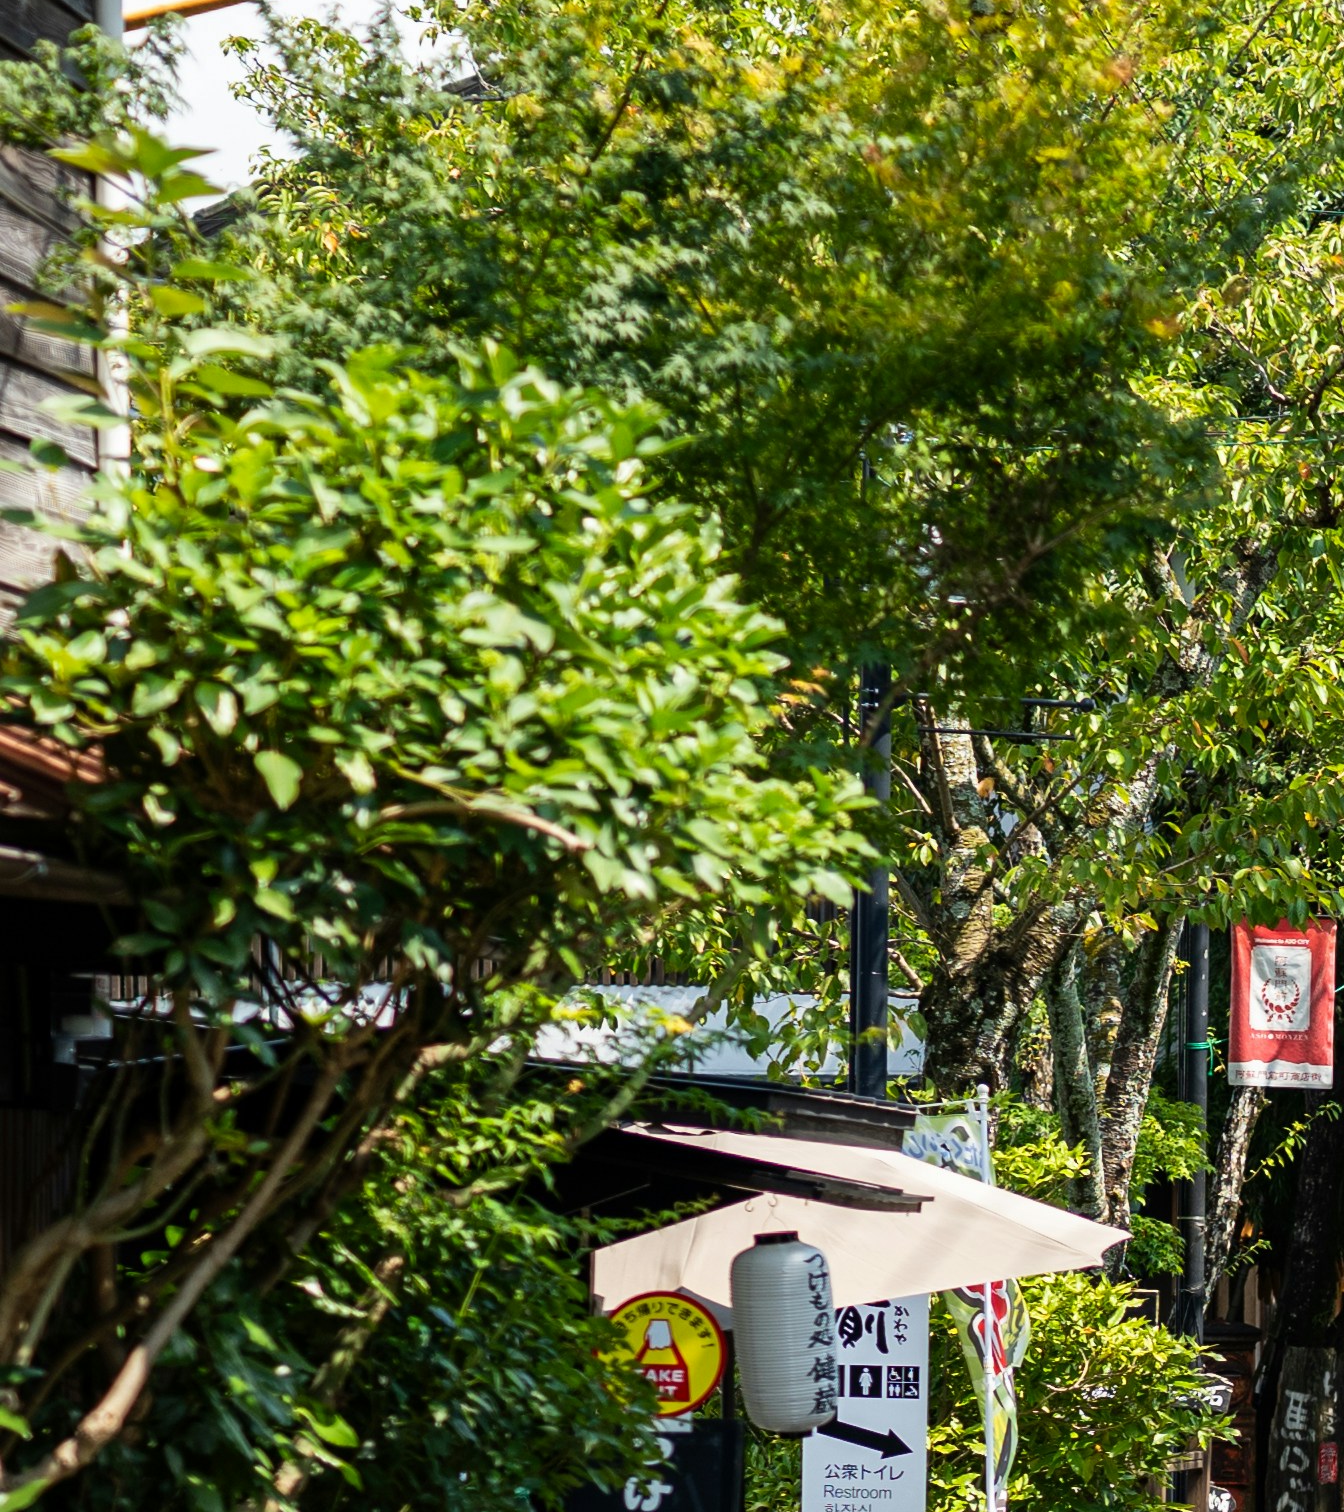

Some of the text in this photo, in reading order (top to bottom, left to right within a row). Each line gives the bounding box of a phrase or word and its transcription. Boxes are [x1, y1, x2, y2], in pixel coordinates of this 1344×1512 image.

[804, 1252, 835, 1349] つけもの処
[893, 1304, 911, 1346] かわや
[824, 1463, 905, 1481] 公衆トイレ
[823, 1484, 892, 1500] Restroom
